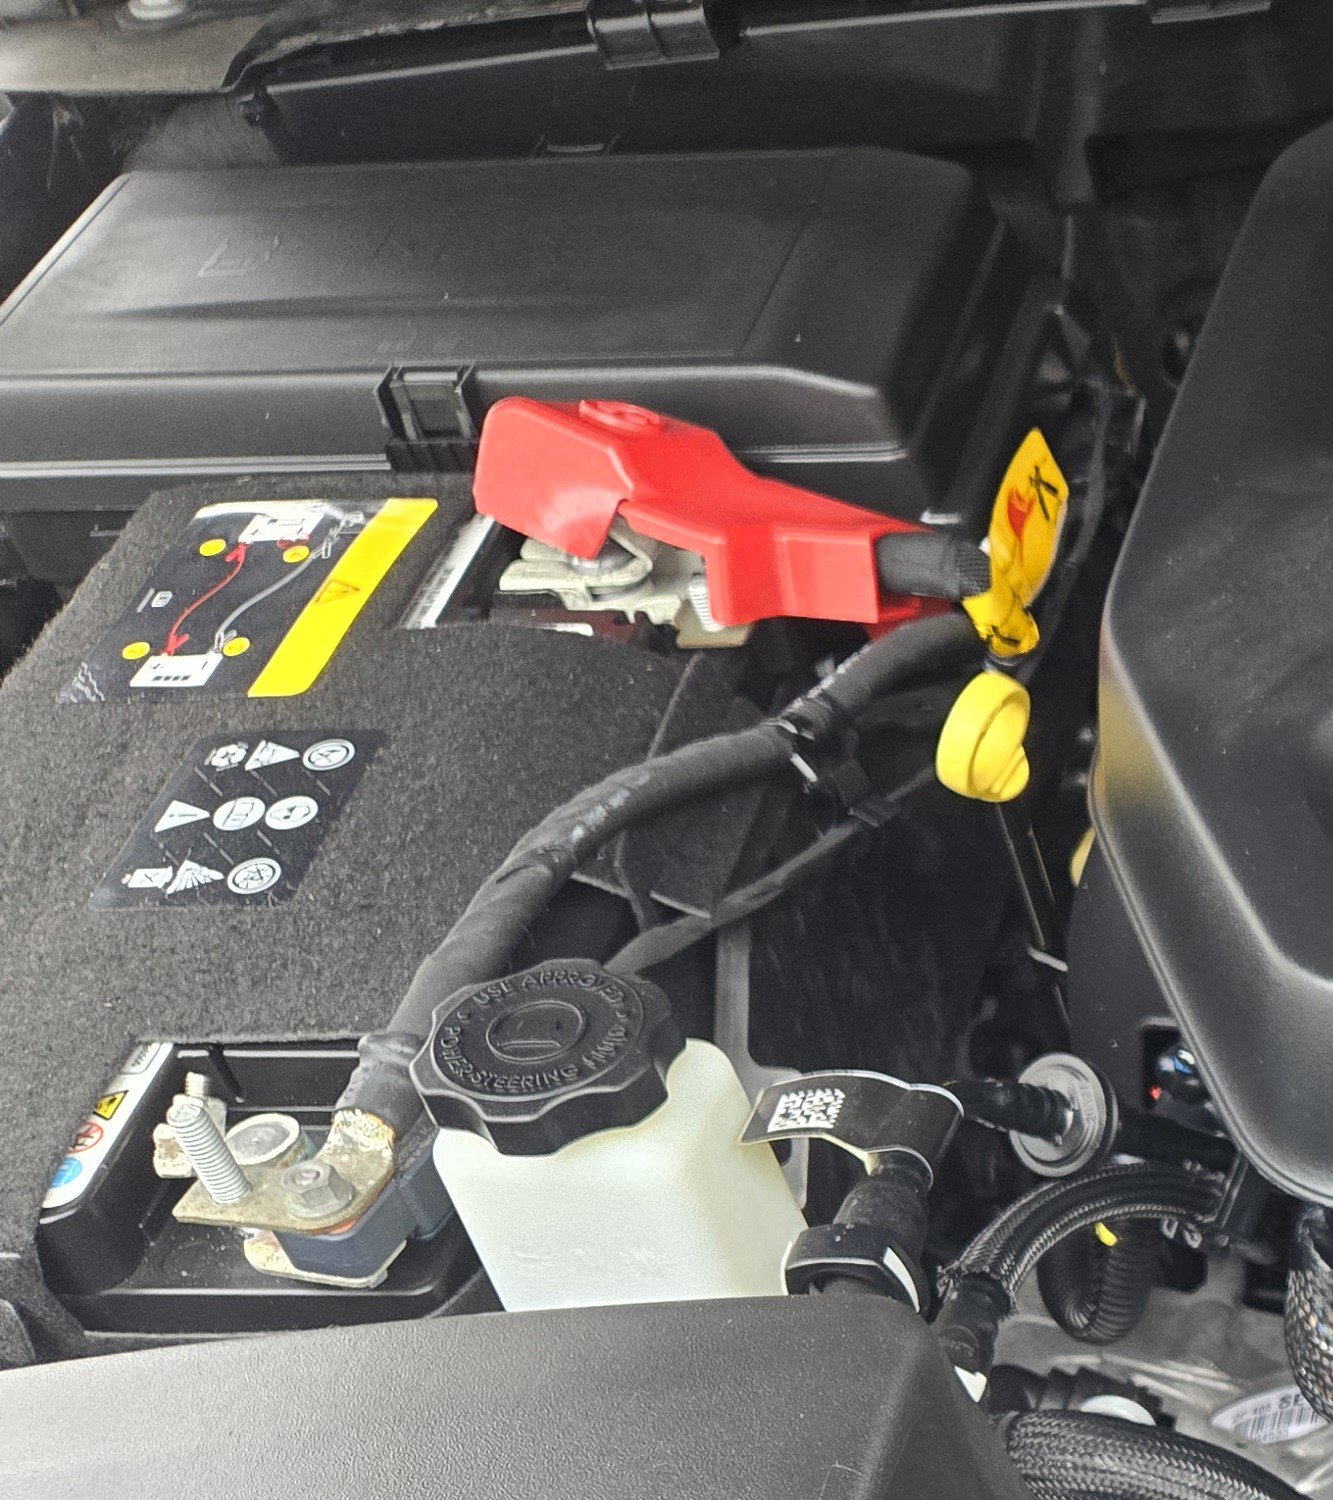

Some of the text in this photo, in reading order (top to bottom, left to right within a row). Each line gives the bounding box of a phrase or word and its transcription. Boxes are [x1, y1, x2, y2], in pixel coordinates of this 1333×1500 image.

[472, 978, 518, 1006] USE
[439, 1025, 475, 1079] POWER
[469, 1063, 582, 1094] STEERING
